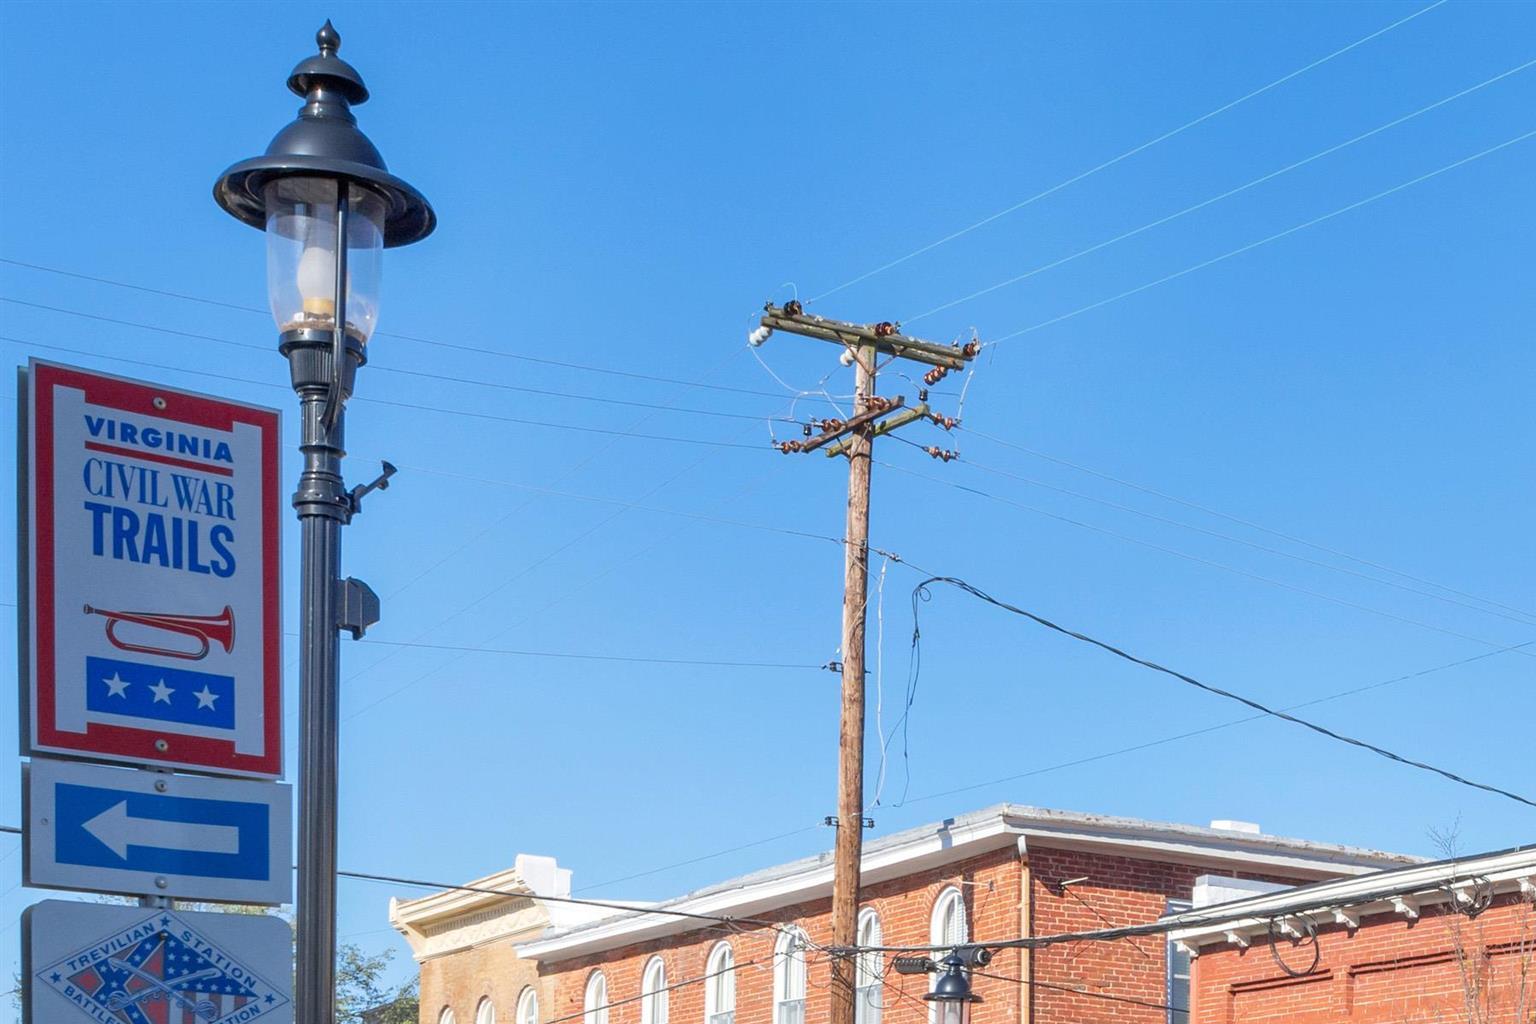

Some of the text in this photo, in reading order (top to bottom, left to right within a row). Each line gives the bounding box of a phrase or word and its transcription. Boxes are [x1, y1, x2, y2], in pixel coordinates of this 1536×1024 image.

[84, 415, 234, 463] VIRGINIA
[83, 457, 236, 521] CIVIL WAR
[84, 502, 236, 578] TRAILS
[67, 922, 156, 972] TREVILIAN
[180, 930, 257, 988] STATION
